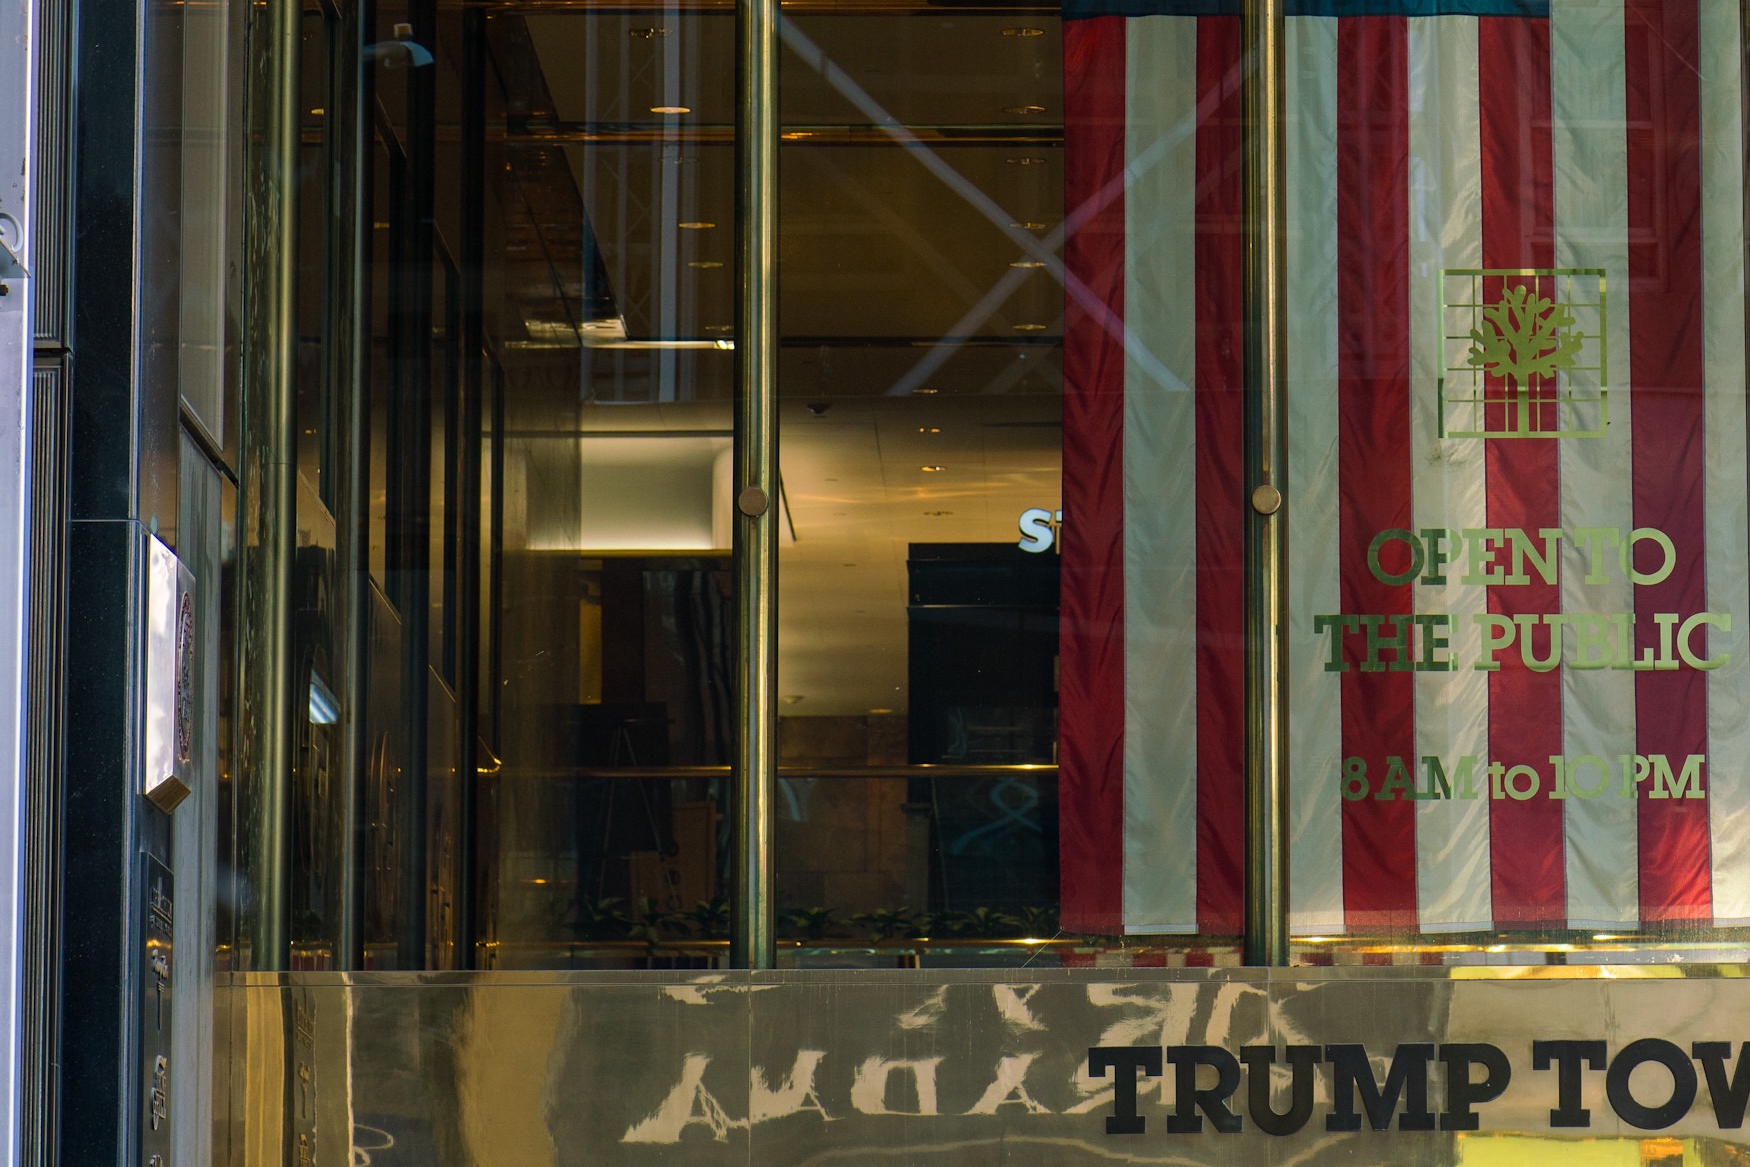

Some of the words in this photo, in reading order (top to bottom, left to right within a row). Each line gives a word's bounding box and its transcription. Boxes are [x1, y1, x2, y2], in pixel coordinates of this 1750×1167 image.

[1367, 527, 1563, 586] OPEN
[1573, 527, 1677, 586] TO
[1314, 614, 1458, 672] THE
[1473, 613, 1732, 672] PUBLIC
[1340, 755, 1369, 802] 8
[1375, 755, 1478, 801] AM
[1488, 757, 1540, 801] to
[1549, 754, 1611, 801] 10
[1618, 754, 1706, 801] PM
[1088, 1042, 1512, 1136] TRUMP
